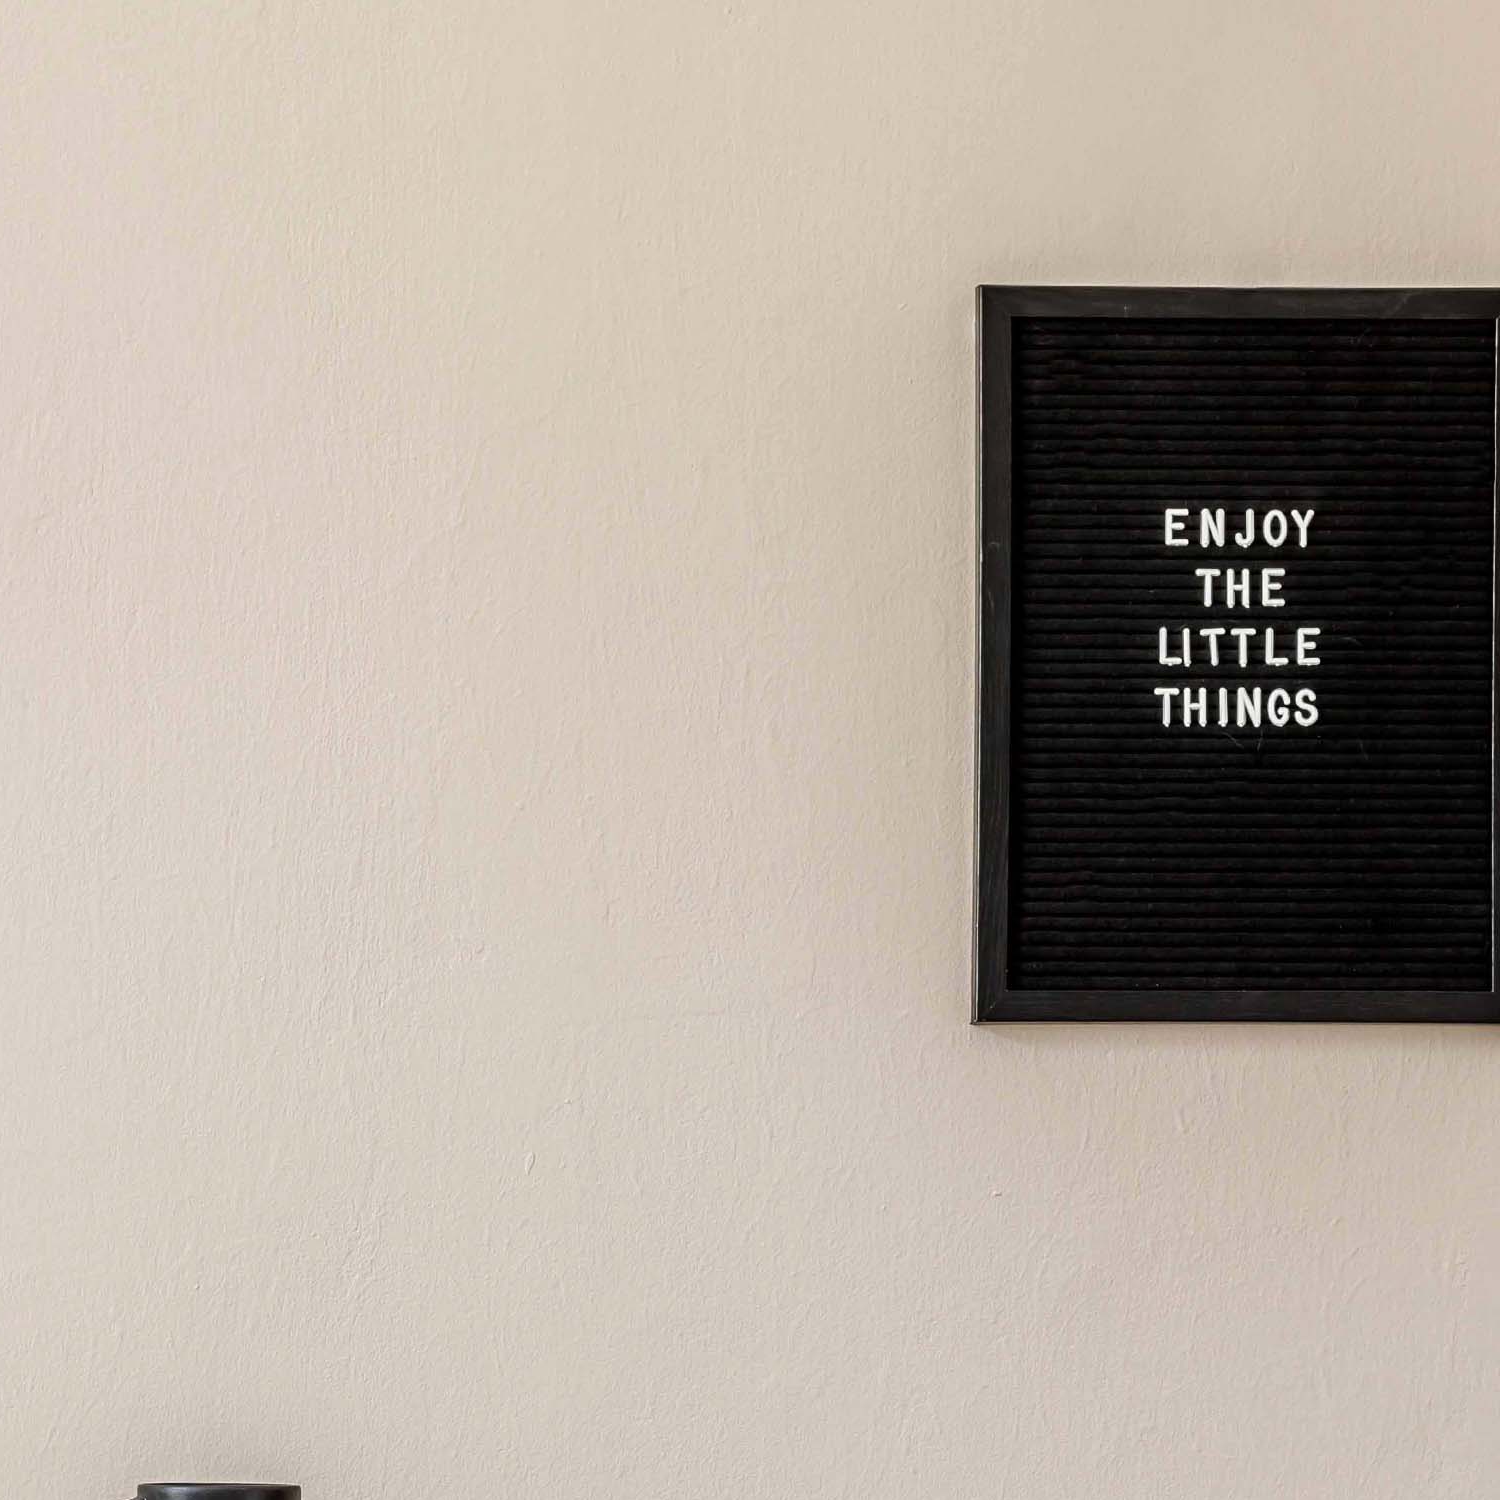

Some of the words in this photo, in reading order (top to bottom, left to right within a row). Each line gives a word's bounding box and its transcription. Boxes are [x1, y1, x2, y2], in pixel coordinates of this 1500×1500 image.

[1164, 508, 1315, 548] ENJOY
[1194, 568, 1286, 608] THE
[1158, 627, 1321, 668] LITTLE
[1153, 687, 1319, 728] THINGS
